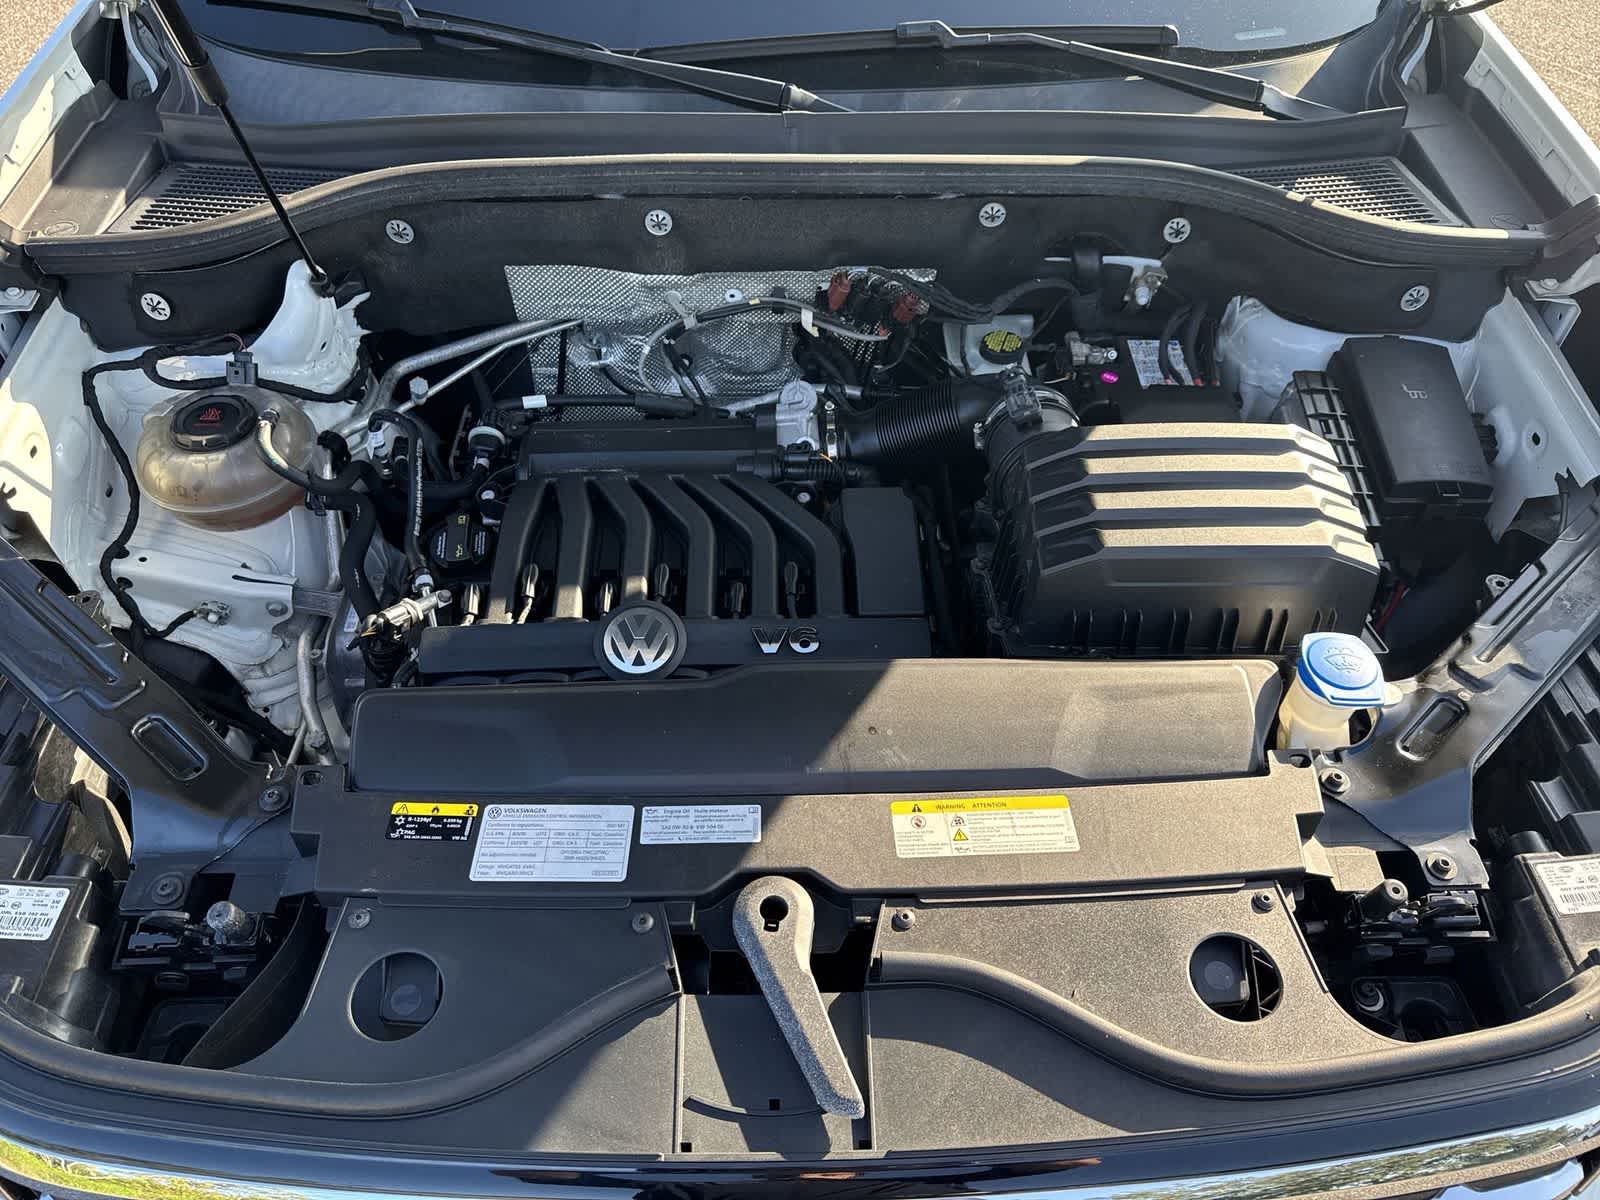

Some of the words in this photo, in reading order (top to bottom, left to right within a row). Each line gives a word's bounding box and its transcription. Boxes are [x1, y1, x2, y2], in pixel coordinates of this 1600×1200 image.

[604, 607, 675, 674] VW
[752, 626, 820, 654] V6
[972, 801, 1007, 809] ATTENTION
